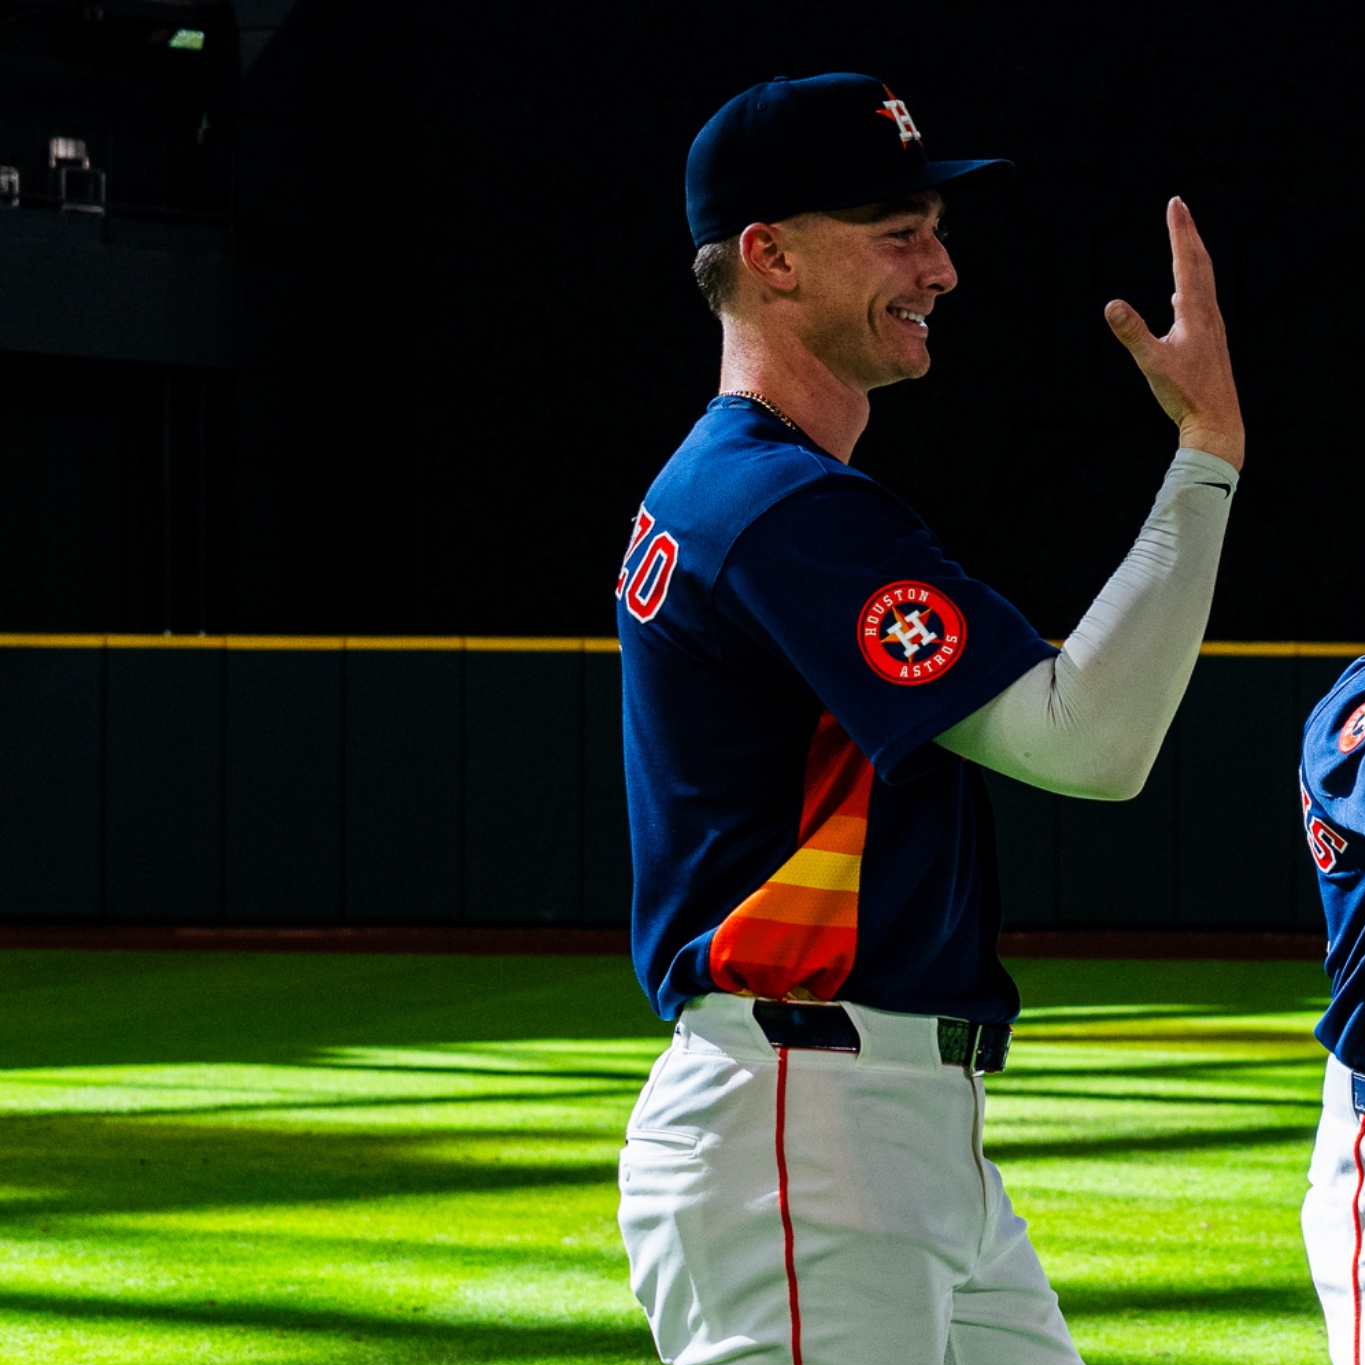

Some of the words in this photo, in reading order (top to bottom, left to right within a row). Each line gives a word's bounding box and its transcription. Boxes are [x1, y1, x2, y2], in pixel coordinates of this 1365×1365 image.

[864, 588, 930, 637] HOUSTON
[886, 609, 939, 659] H
[899, 634, 959, 679] ASTROS
